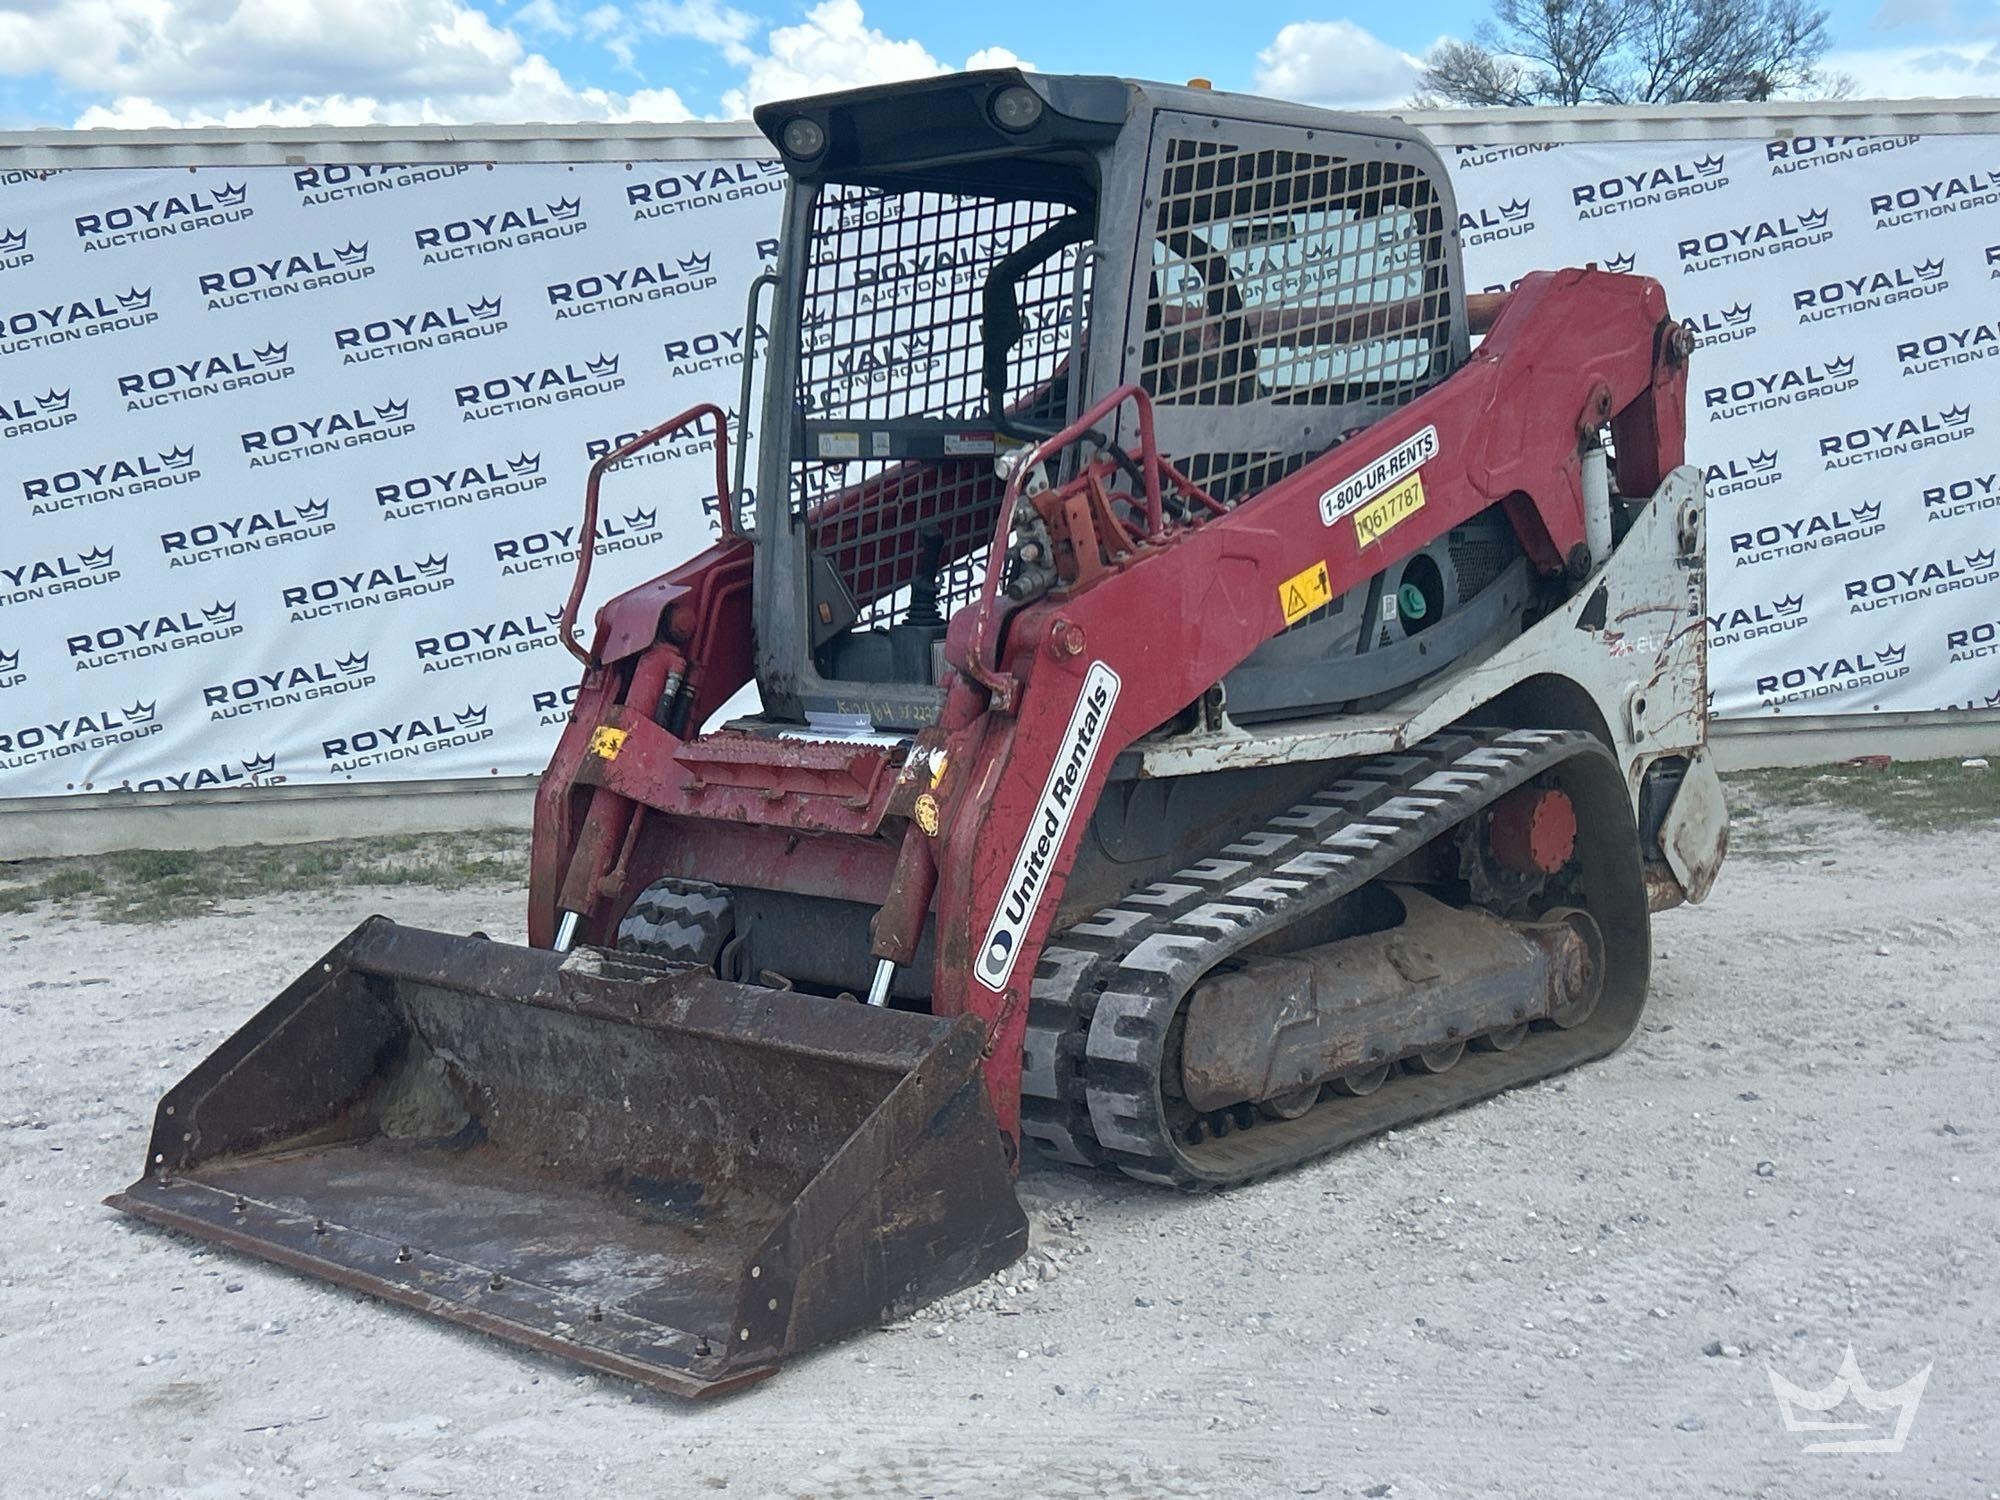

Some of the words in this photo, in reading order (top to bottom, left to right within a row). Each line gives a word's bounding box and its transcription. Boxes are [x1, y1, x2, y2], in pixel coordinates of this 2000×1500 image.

[1460, 143, 1542, 170] AUCTION
[1772, 149, 1853, 176] AUCTION
[1856, 135, 1920, 157] GROUP
[302, 178, 394, 207] AUCTION
[397, 164, 469, 186] GROUP
[626, 163, 758, 206] ROYAL
[634, 193, 723, 221] AUCTION
[726, 178, 787, 200] GROU
[1573, 165, 1694, 206] ROYAL
[1579, 193, 1660, 221] AUCTION
[1664, 177, 1729, 201] GROUP
[1870, 174, 1989, 216] ROYAL
[75, 193, 213, 237] ROYAL
[84, 224, 177, 252] AUCTION
[180, 208, 254, 232] GROUP
[414, 207, 549, 250] ROYAL
[1470, 222, 1535, 246] GROUP
[1876, 202, 1956, 230] AUCTION
[423, 237, 513, 265] AUCTION
[516, 222, 587, 245] GROUP
[1678, 218, 1798, 260] ROYAL
[1684, 247, 1765, 275] AUCTION
[1768, 231, 1833, 254] GROUP
[199, 252, 336, 296] ROYAL
[208, 282, 300, 311] AUCTION
[303, 266, 375, 290] GROUP
[547, 263, 679, 305] ROYAL
[1793, 269, 1914, 310] ROYAL
[0, 298, 118, 338] OYAL
[555, 292, 644, 320] AUCTION
[647, 277, 717, 300] GROUP
[1799, 297, 1880, 325] AUCTION
[1884, 281, 1949, 304] GROUP
[0, 328, 82, 355] UCTION
[85, 312, 158, 336] GROUP
[334, 307, 470, 350] ROYAL
[343, 337, 434, 365] AUCTION
[437, 321, 508, 345] GROUP
[1694, 327, 1757, 349] GROUP
[1897, 323, 2000, 363] ROYA
[118, 353, 255, 397] ROYAL
[1903, 349, 1983, 377] AUCTION
[127, 383, 219, 412] AUCTION
[222, 367, 295, 391] GROUP
[454, 365, 587, 407] ROYAL
[463, 394, 552, 422] AUCTION
[555, 379, 625, 402] GROUP
[1704, 366, 1825, 408] ROYAL
[1710, 394, 1791, 422] AUCTION
[1794, 378, 1859, 402] GROUP
[4, 413, 77, 438] GROUP
[240, 409, 376, 453] ROYAL
[250, 440, 341, 469] AUCTION
[344, 423, 416, 447] GROUP
[1819, 415, 1941, 457] ROYAL
[1825, 443, 1907, 471] AUCTION
[1910, 427, 1975, 450] GROUP
[23, 456, 161, 501] ROYAL
[32, 487, 124, 516] AUCTION
[128, 470, 201, 494] GROUP
[375, 463, 508, 506] ROYAL
[1326, 433, 1433, 516] 1-800-UR-RENTS
[1718, 473, 1782, 496] GROUP
[1923, 473, 1999, 508] ROY
[384, 493, 473, 521] AUCTION
[477, 477, 547, 500] GROUP
[161, 509, 297, 554] ROYAL
[170, 539, 261, 569] AUCTION
[264, 523, 336, 547] GROUP
[595, 532, 663, 555] GROUP
[1730, 511, 1851, 553] ROYAL
[1736, 539, 1817, 568] AUCTION
[1821, 523, 1886, 547] GROUP
[0, 557, 80, 587] YAL
[48, 570, 121, 595] GROUP
[282, 565, 416, 608] ROYAL
[1845, 559, 1966, 601] ROYAL
[1850, 587, 1932, 615] AUCTION
[1935, 571, 2000, 594] GROUP
[291, 594, 381, 623] AUCTION
[384, 578, 455, 602] GROUP
[1706, 604, 1774, 632] YAL
[66, 612, 203, 657] ROYAL
[76, 642, 168, 671] AUCTION
[171, 625, 243, 650] GROUP
[415, 616, 547, 659] ROYAL
[1743, 616, 1808, 640] GROUP
[423, 645, 512, 674] AUCTION
[515, 629, 585, 652] GROP
[202, 662, 337, 707] ROYAL
[1755, 654, 1876, 696] ROYAL
[1762, 682, 1842, 708] AUCTION
[1846, 666, 1910, 690] GROUP
[211, 692, 301, 721] AUCTION
[304, 675, 376, 700] GROUP
[90, 724, 163, 749] GROUP
[322, 716, 455, 759] ROYAL
[331, 745, 420, 774] AUCTION
[423, 729, 494, 752] GROUP
[1006, 808, 1059, 925] United
